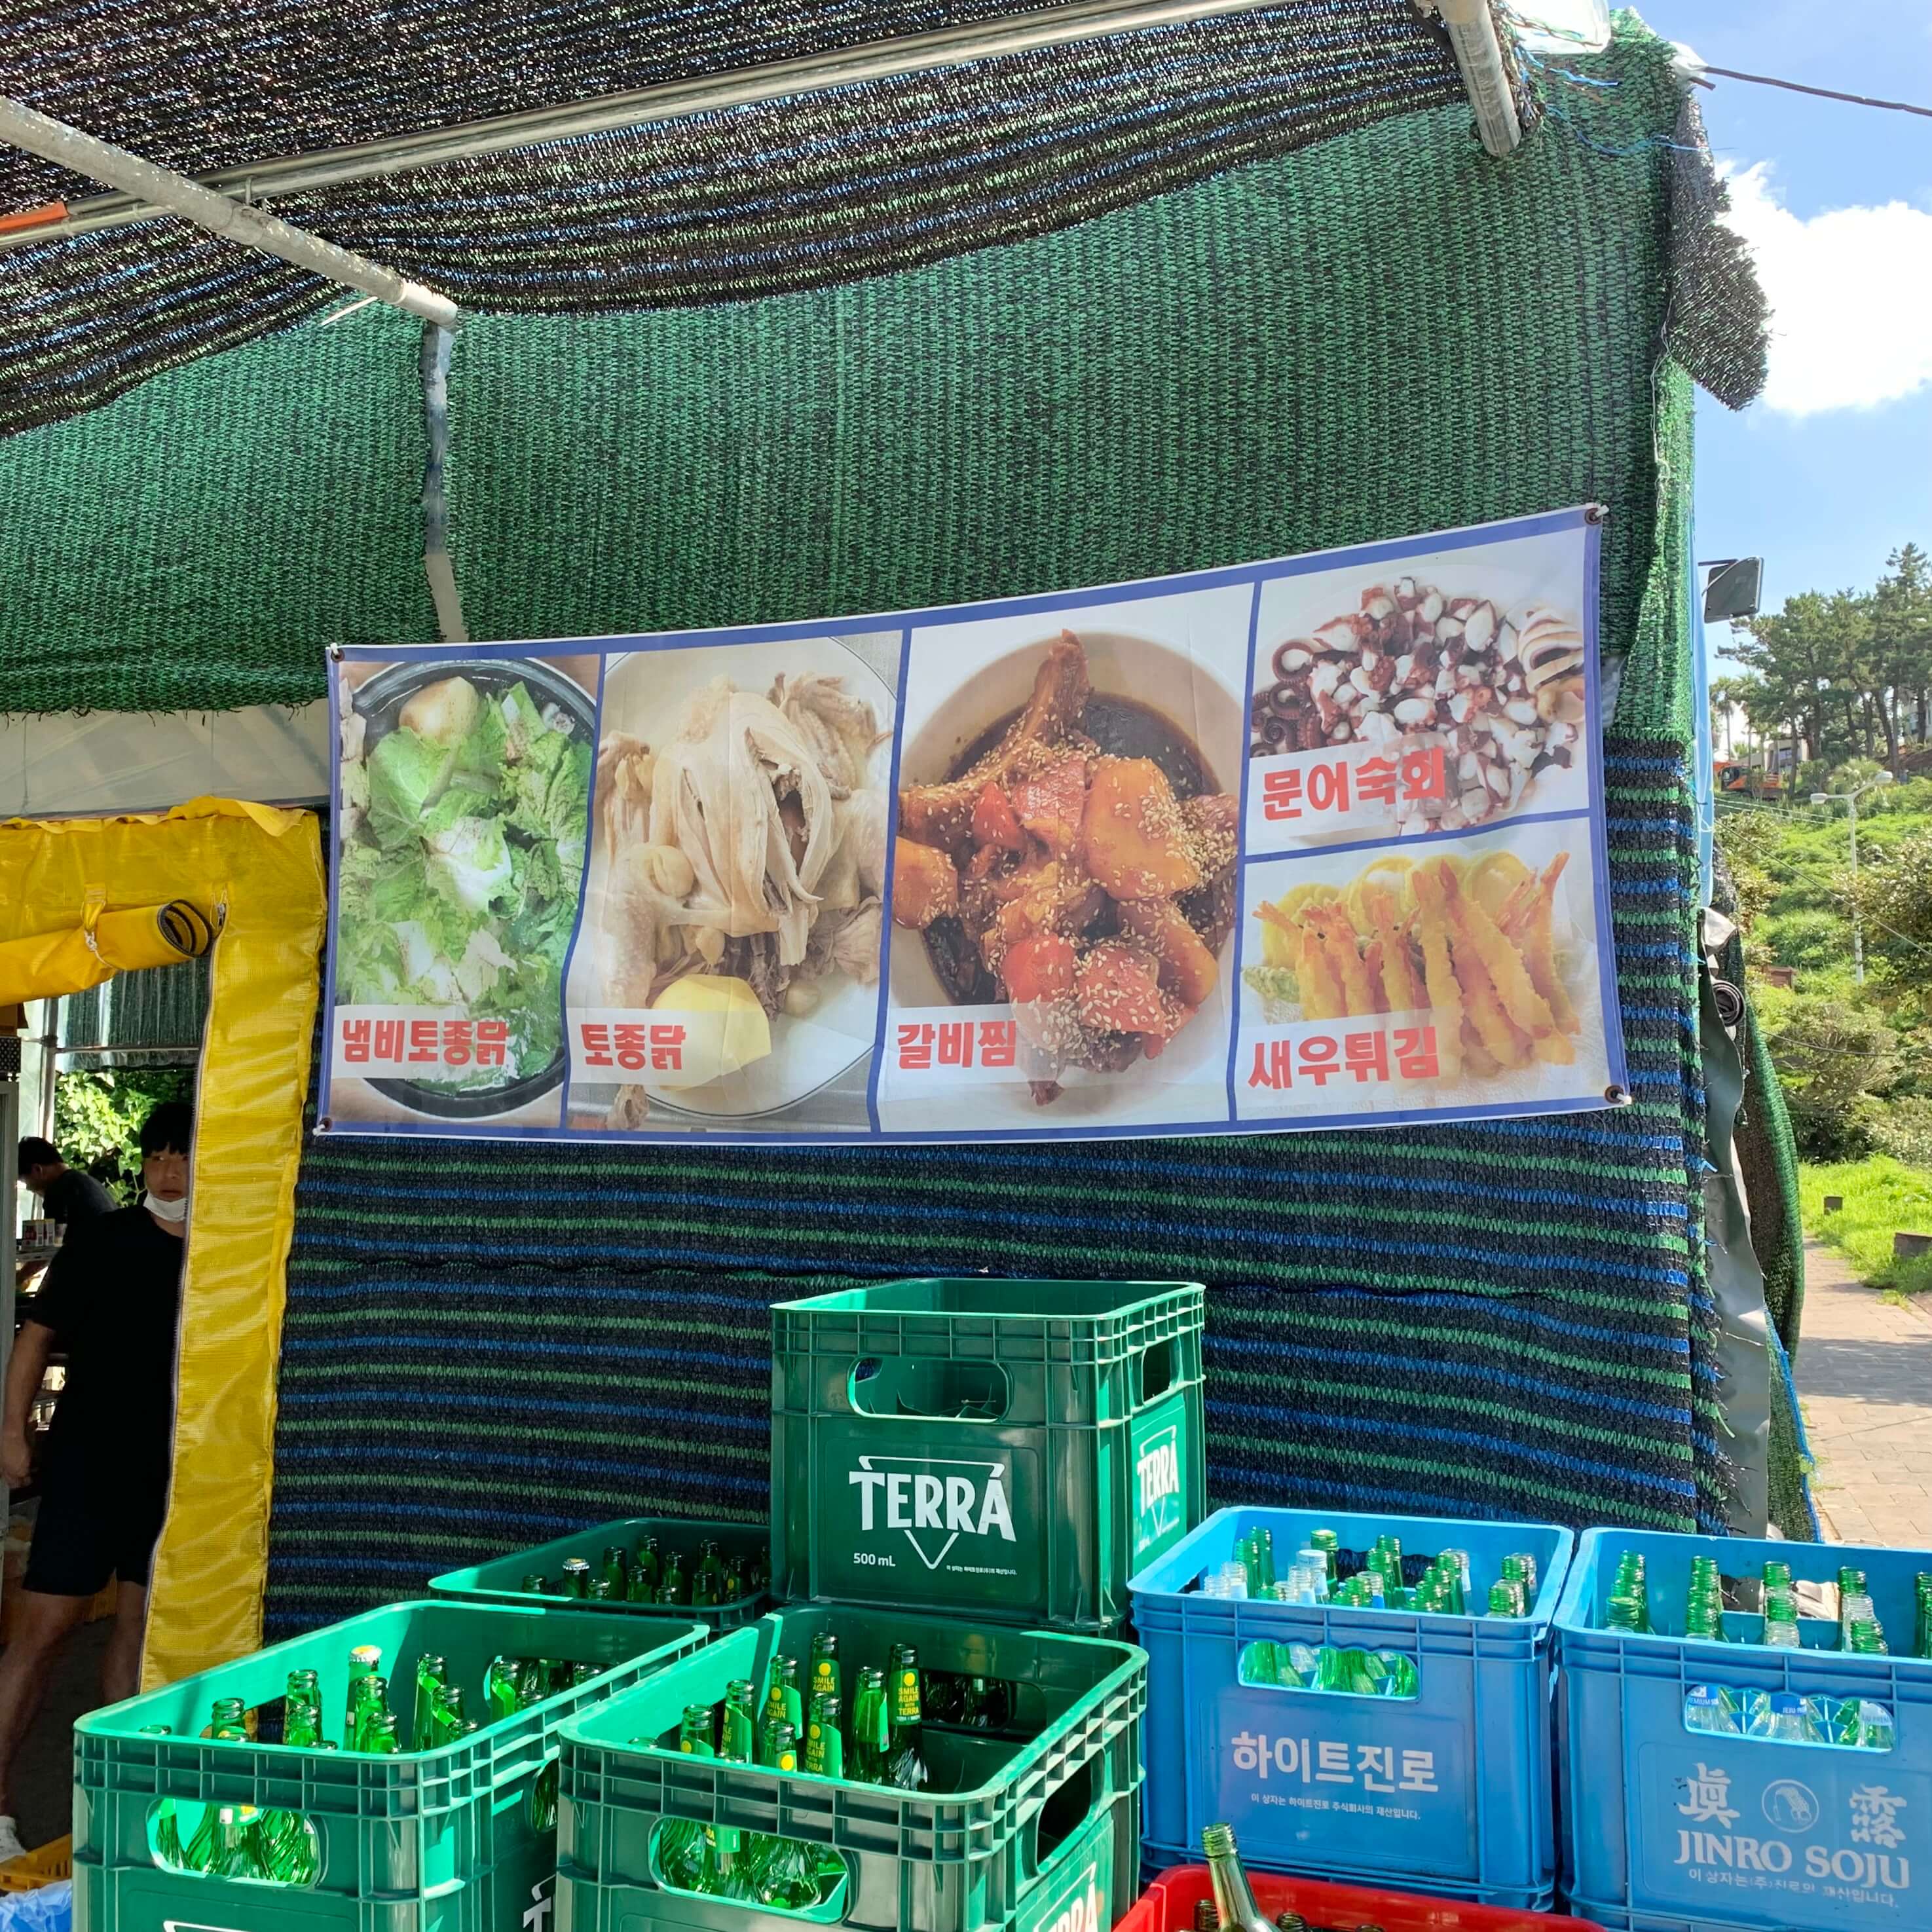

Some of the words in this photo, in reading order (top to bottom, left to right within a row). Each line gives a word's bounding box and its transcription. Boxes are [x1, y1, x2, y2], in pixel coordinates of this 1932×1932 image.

[343, 1019, 510, 1066] 냄비토종닭
[580, 1023, 687, 1071] 토종닭
[897, 1020, 1016, 1069] 갈비찜
[1248, 1026, 1440, 1090] 새우튀김
[1137, 1438, 1180, 1518] TERRA
[849, 1470, 1017, 1542] TERRA
[853, 1552, 876, 1565] 500
[878, 1555, 897, 1567] mL
[813, 1676, 835, 1685] SMILE
[813, 1682, 835, 1692] AGAIN
[898, 1686, 920, 1695] SMILE
[898, 1693, 920, 1703] AGAIN
[898, 1707, 920, 1716] TERRA
[1231, 1731, 1439, 1794] 하이트진로
[1251, 1793, 1259, 1802] 이
[1263, 1794, 1286, 1806] 상자는
[1289, 1796, 1330, 1810] 하이트진로
[1377, 1806, 1421, 1820] 재산입니다.
[1673, 1829, 1793, 1872] JINRO
[1805, 1845, 1910, 1889] SOJU
[1688, 1868, 1701, 1882] 이
